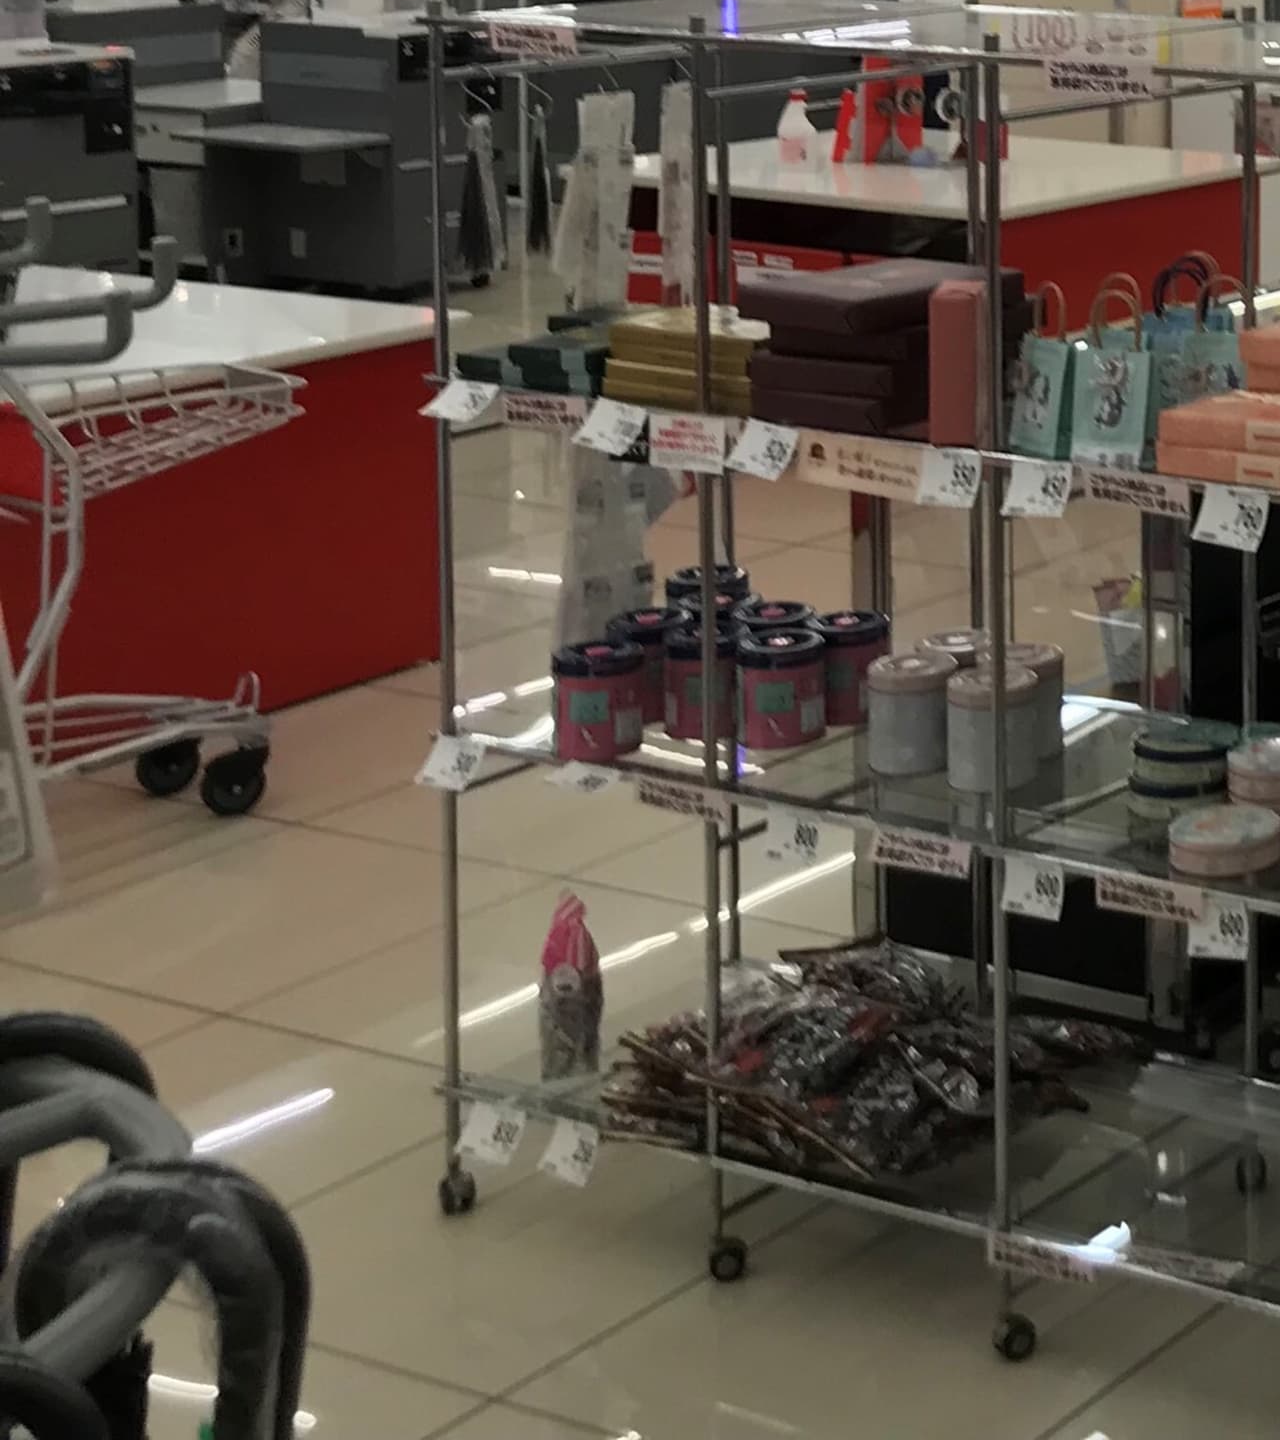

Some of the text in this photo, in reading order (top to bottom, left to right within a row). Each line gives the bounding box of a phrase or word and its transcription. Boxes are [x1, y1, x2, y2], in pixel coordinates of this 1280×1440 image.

[952, 464, 977, 488] 550
[1035, 872, 1061, 898] 600
[1219, 911, 1245, 937] 600
